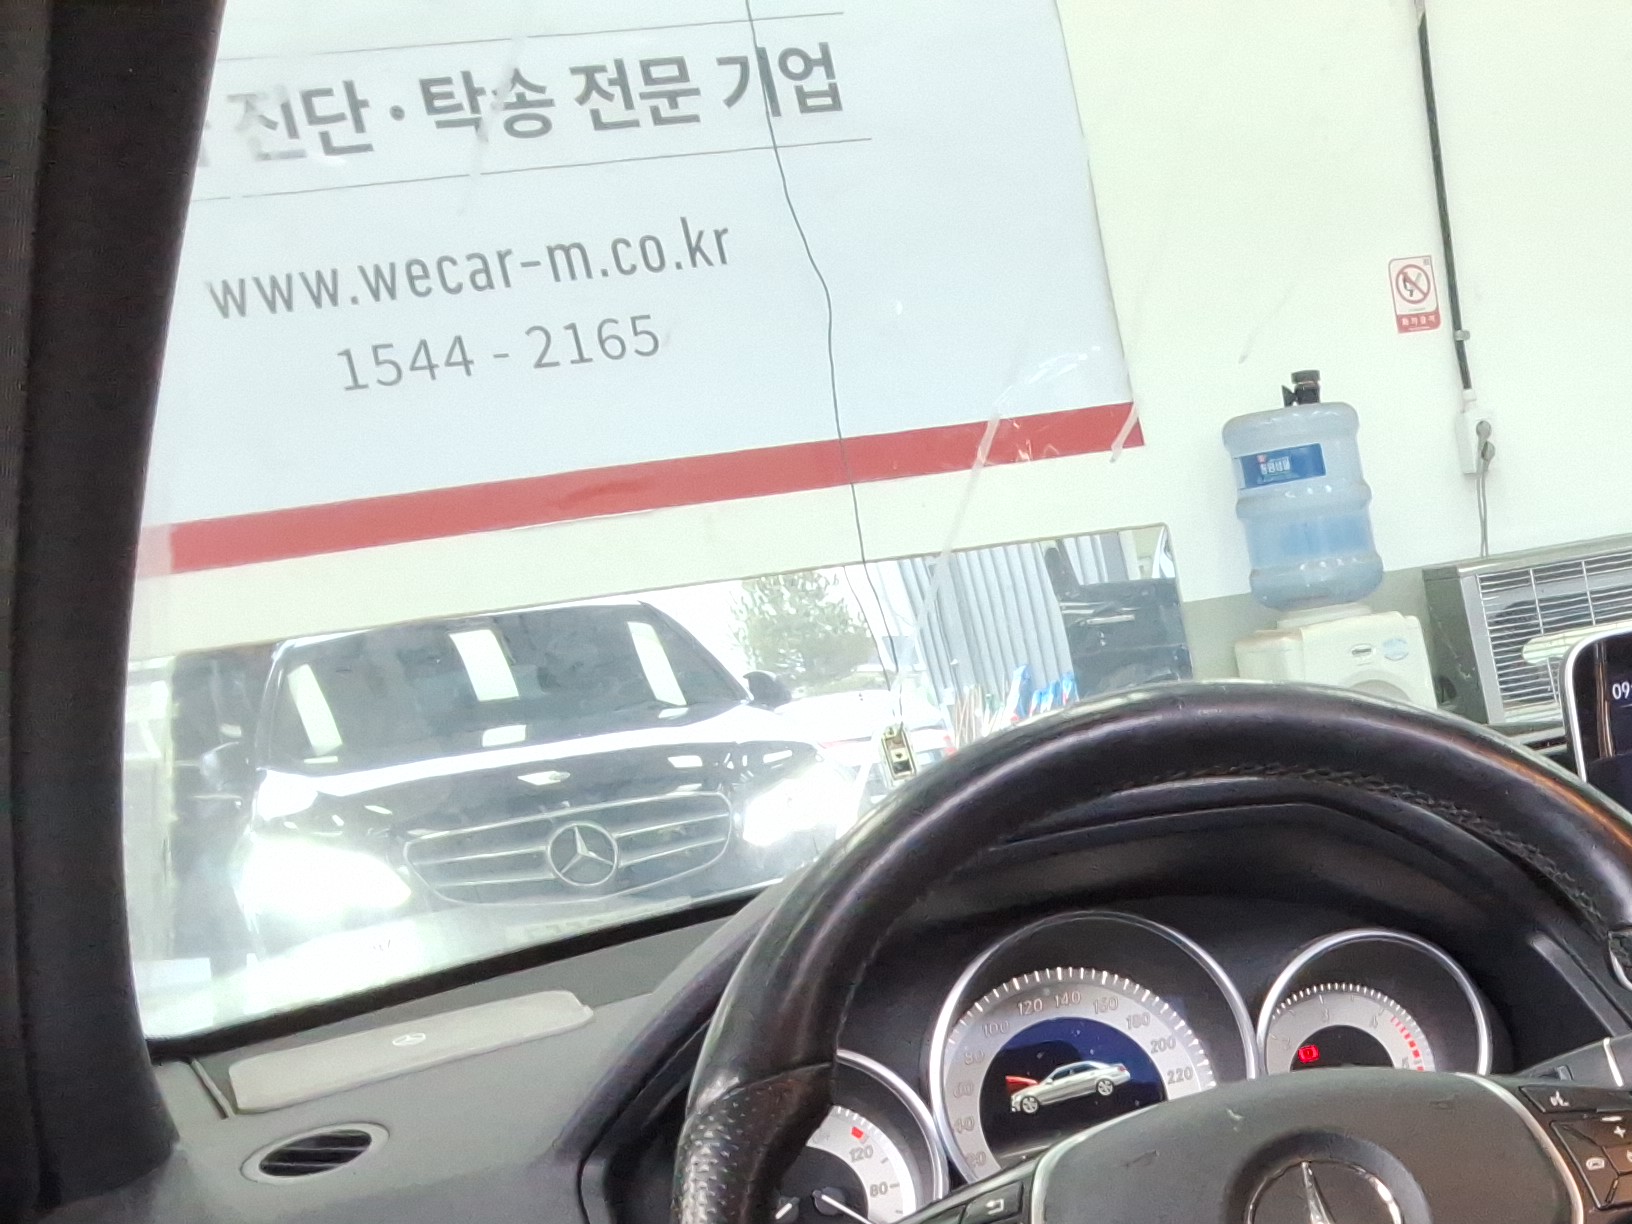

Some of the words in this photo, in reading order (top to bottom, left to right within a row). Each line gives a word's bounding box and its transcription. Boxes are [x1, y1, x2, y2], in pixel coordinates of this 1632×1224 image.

[570, 54, 702, 131] 전문
[715, 41, 845, 118] 기업
[206, 216, 732, 320] www.wecar-m.co.kr
[1017, 998, 1043, 1016] 120
[1054, 991, 1081, 1008] 140
[1150, 1037, 1176, 1054] 200
[1167, 1067, 1193, 1085] 220
[850, 1145, 875, 1163] 120
[869, 1181, 889, 1198] 80
